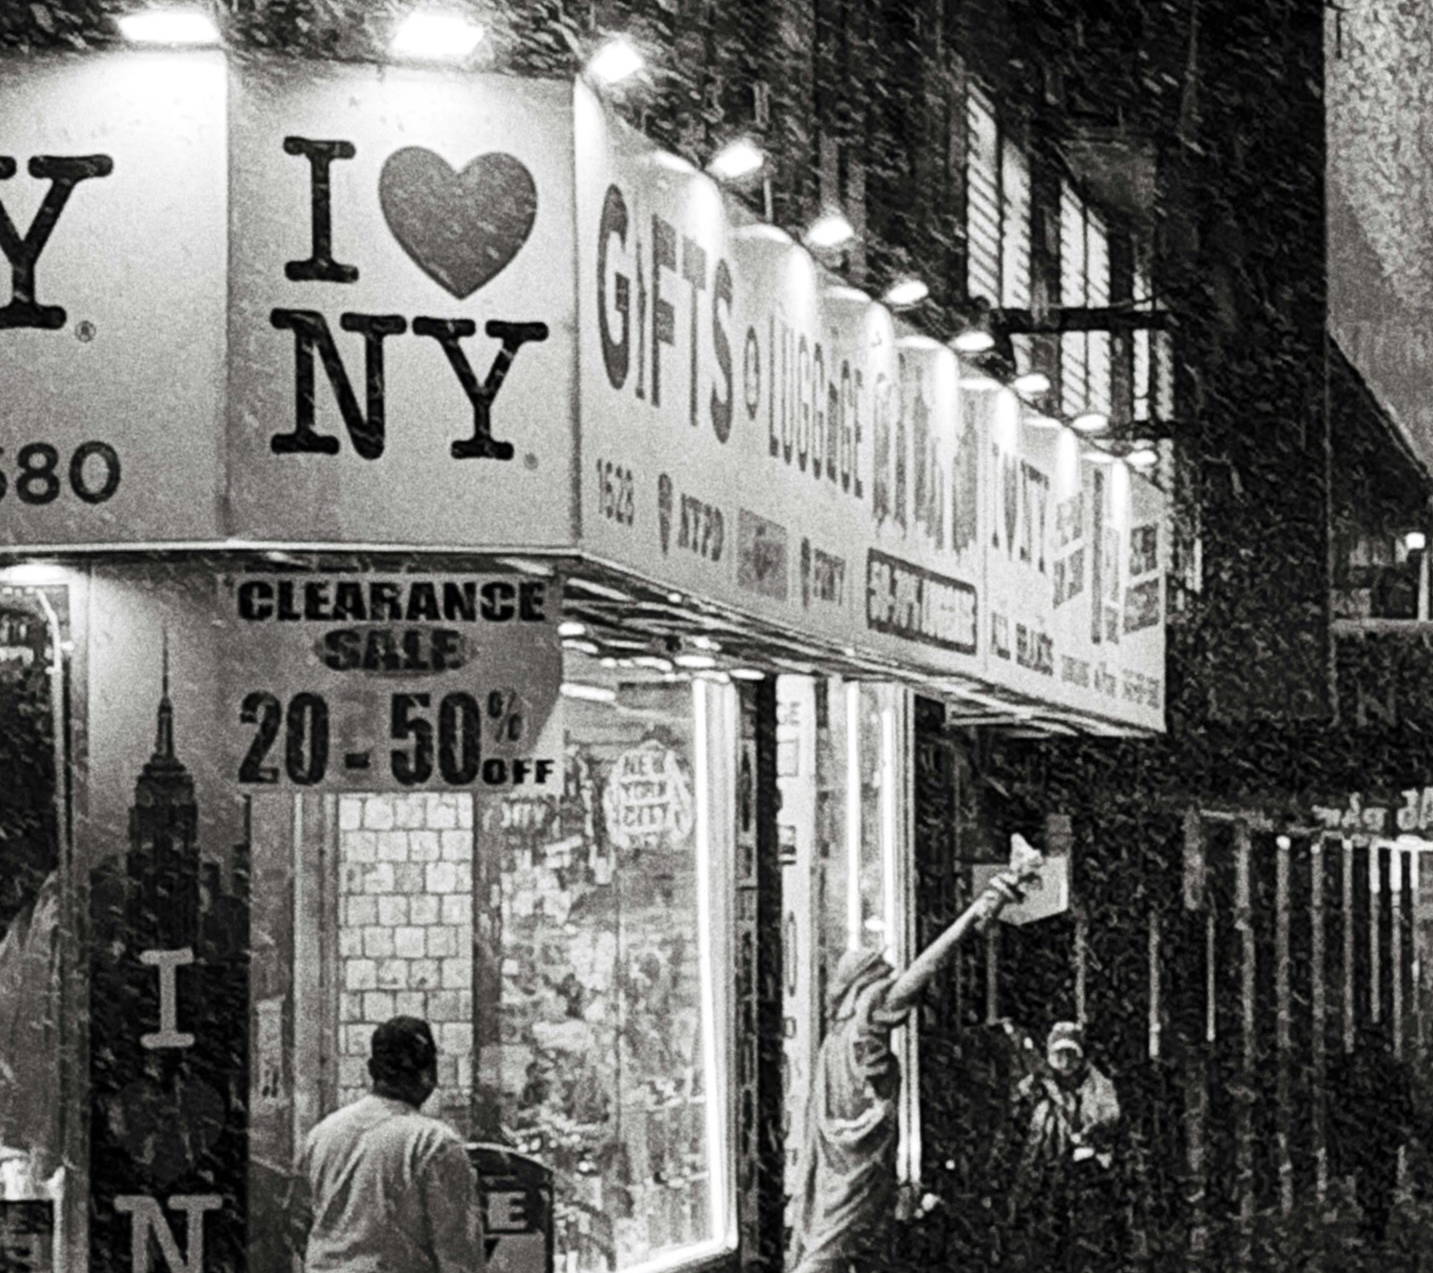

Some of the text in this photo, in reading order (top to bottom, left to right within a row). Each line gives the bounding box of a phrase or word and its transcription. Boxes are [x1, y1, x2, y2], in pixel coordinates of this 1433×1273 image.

[0, 153, 114, 330] Y
[282, 135, 359, 284] I
[269, 307, 550, 461] NY
[0, 440, 121, 505] 80
[236, 580, 547, 623] CLEARANCE
[322, 629, 465, 672] SALE
[481, 758, 556, 786] OFF
[139, 946, 196, 1050] I
